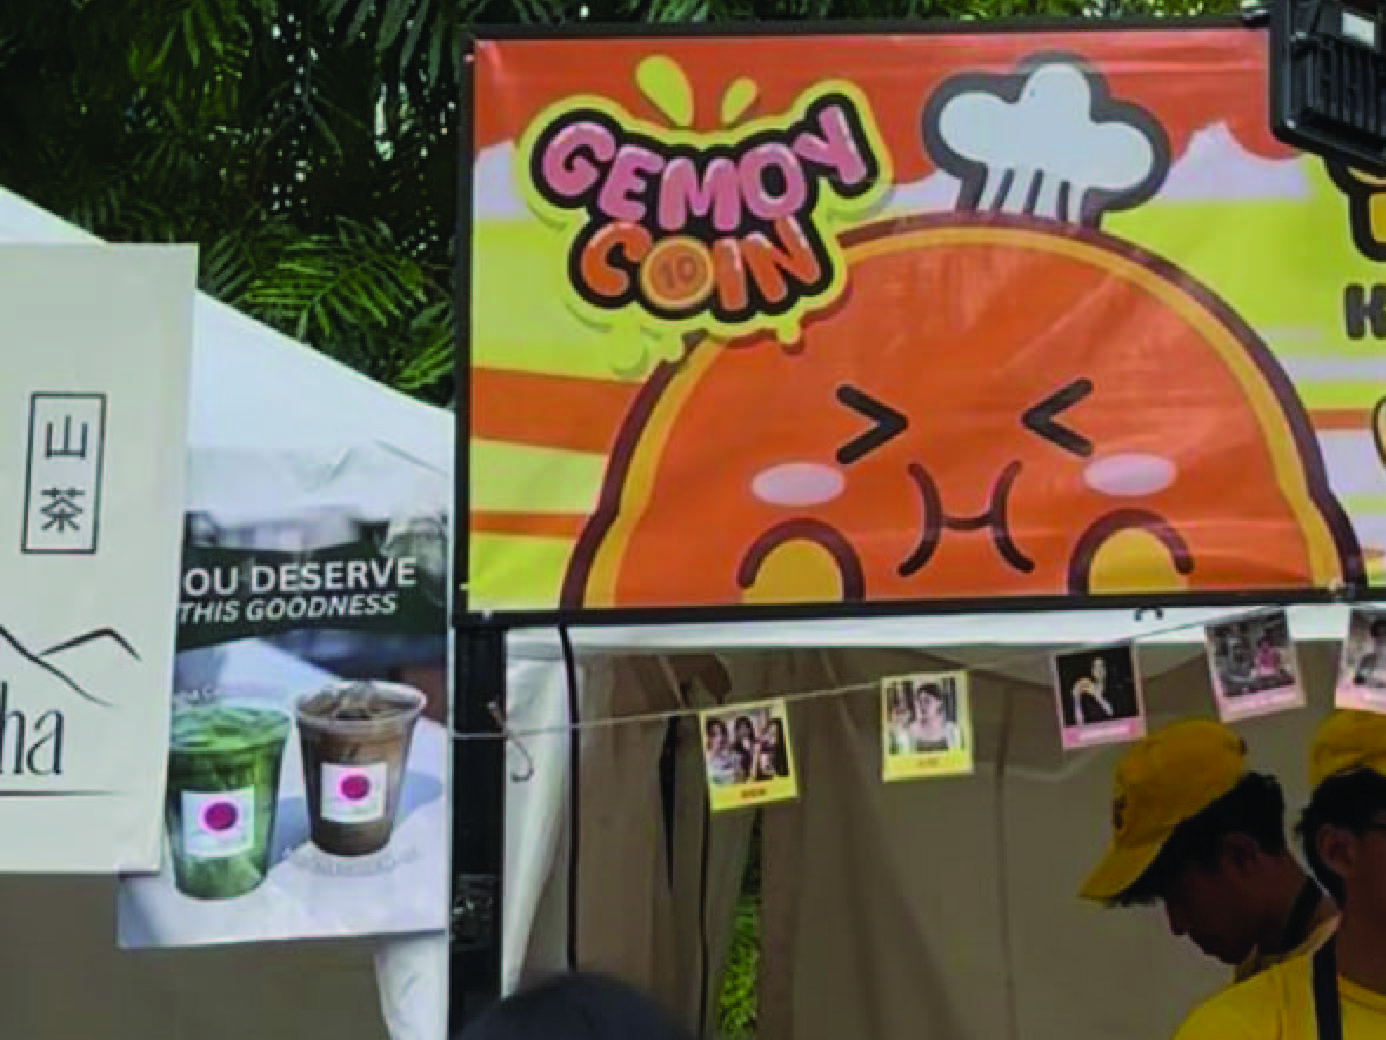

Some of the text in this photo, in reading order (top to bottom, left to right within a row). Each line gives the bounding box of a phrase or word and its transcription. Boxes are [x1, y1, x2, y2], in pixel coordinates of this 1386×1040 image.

[541, 102, 868, 232] GEMOY
[579, 216, 823, 312] COIN
[39, 414, 90, 533] 山茶
[178, 593, 398, 624] THIS GOODNESS
[184, 557, 417, 596] OU DESERVE
